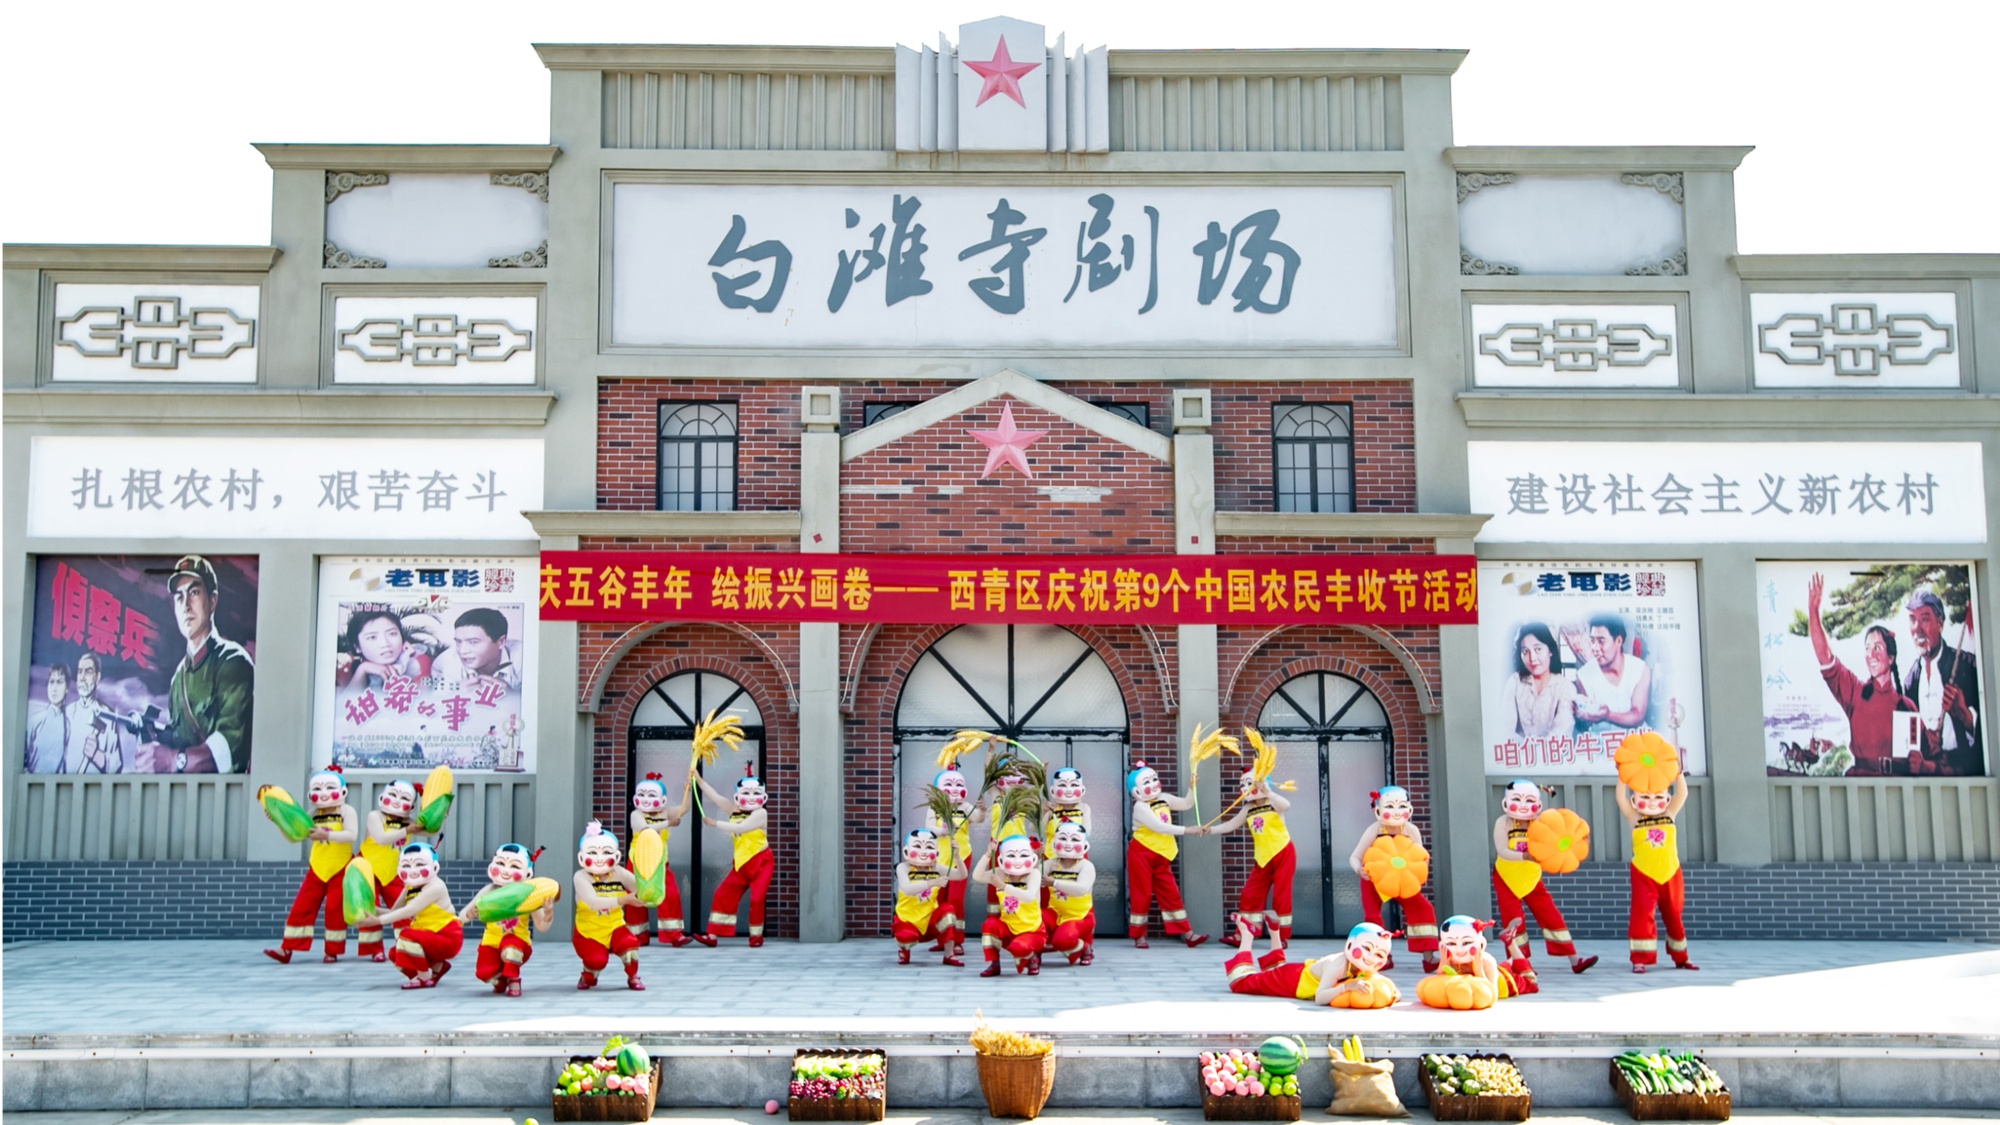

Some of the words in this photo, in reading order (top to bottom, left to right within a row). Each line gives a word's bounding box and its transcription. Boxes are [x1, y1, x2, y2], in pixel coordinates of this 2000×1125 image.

[707, 192, 1302, 315] 白滩寺剧场
[71, 467, 508, 513] 扎根农村，艰苦奋斗
[1506, 472, 1939, 516] 建设社会主义新农村
[385, 568, 480, 588] 老电影
[1537, 572, 1632, 592] 老电影
[345, 676, 506, 732] 甜蜜的事业
[1494, 729, 1655, 769] 咱们的牛百
